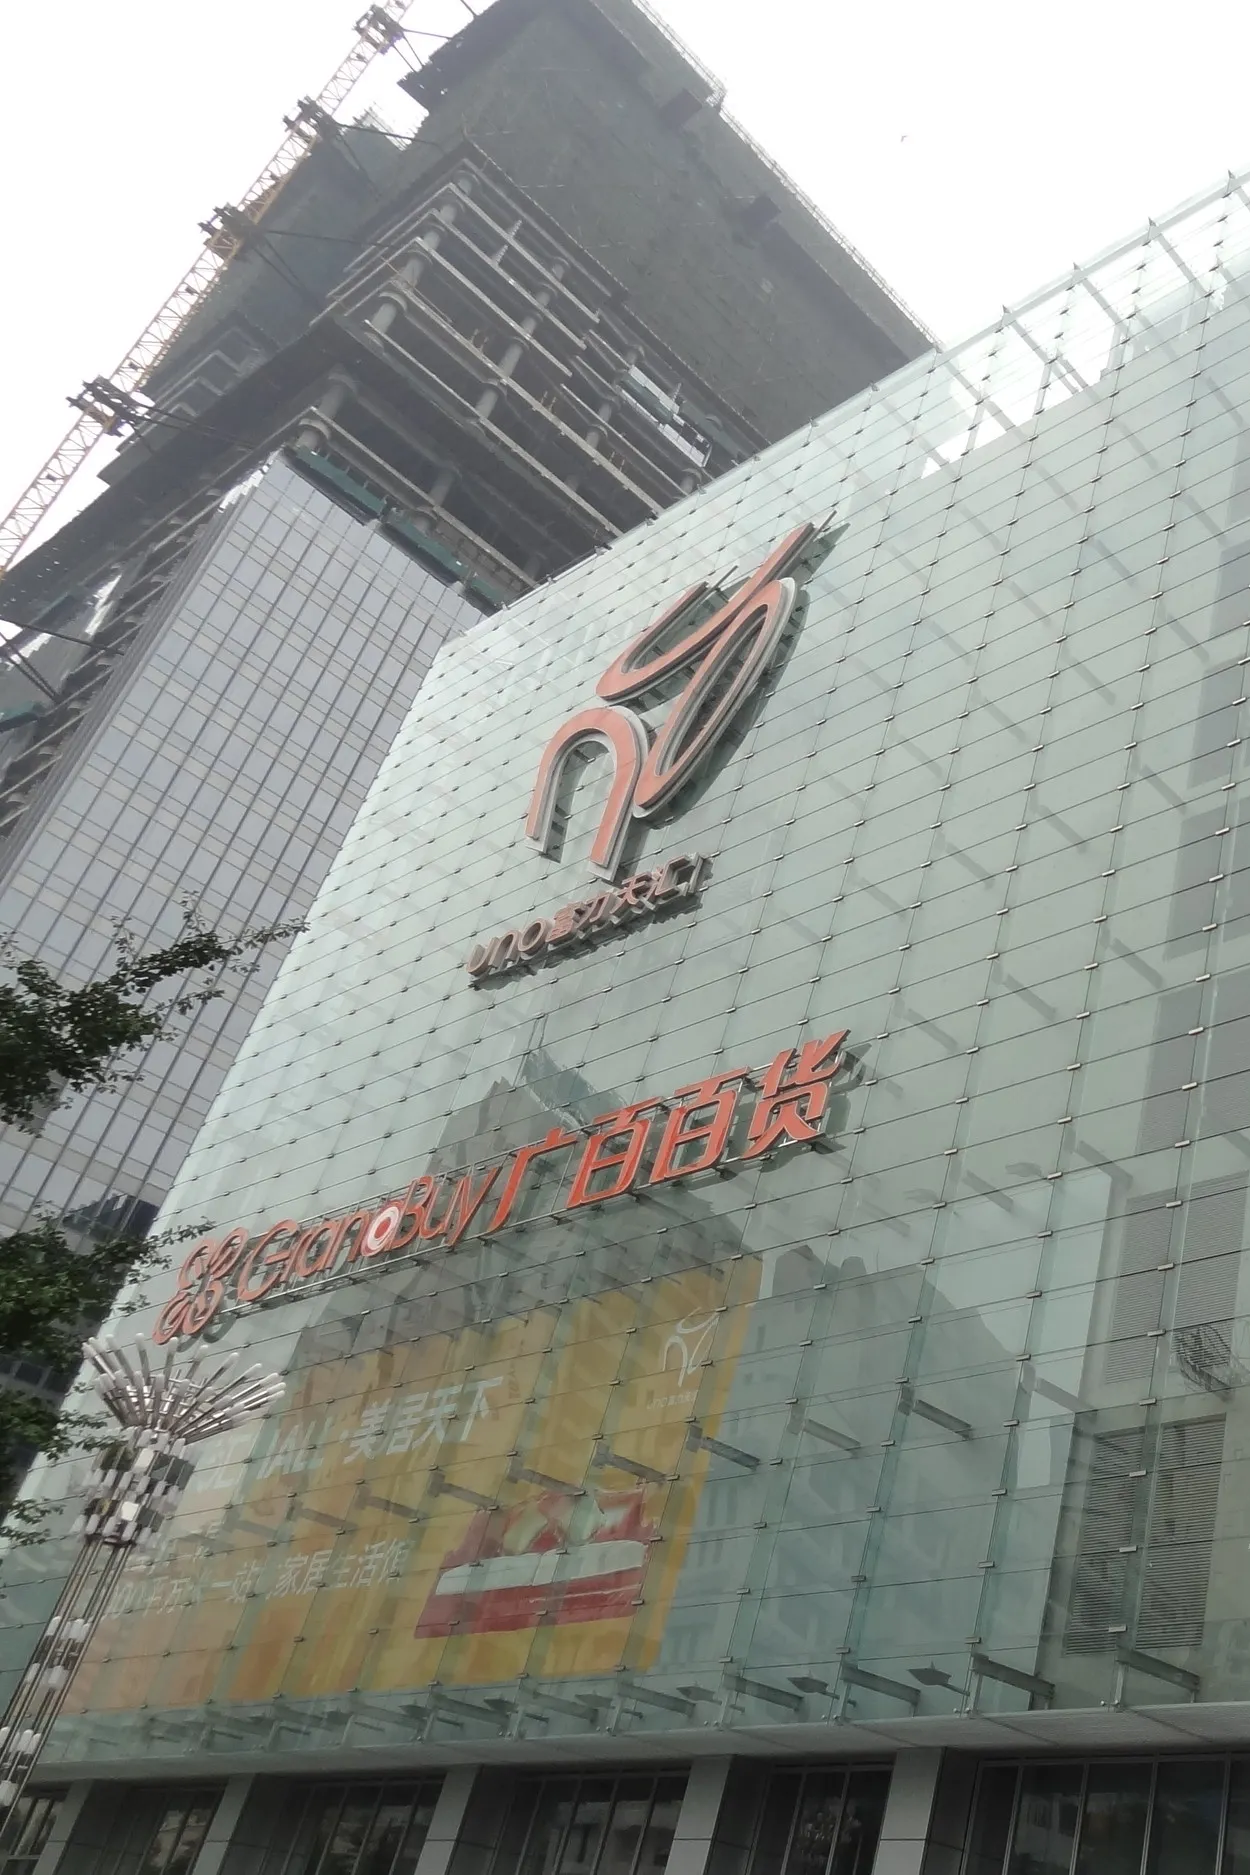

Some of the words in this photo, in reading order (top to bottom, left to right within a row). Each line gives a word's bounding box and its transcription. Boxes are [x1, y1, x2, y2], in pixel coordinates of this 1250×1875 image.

[485, 1029, 851, 1234] 广百百货
[343, 1376, 504, 1464] 美居天下
